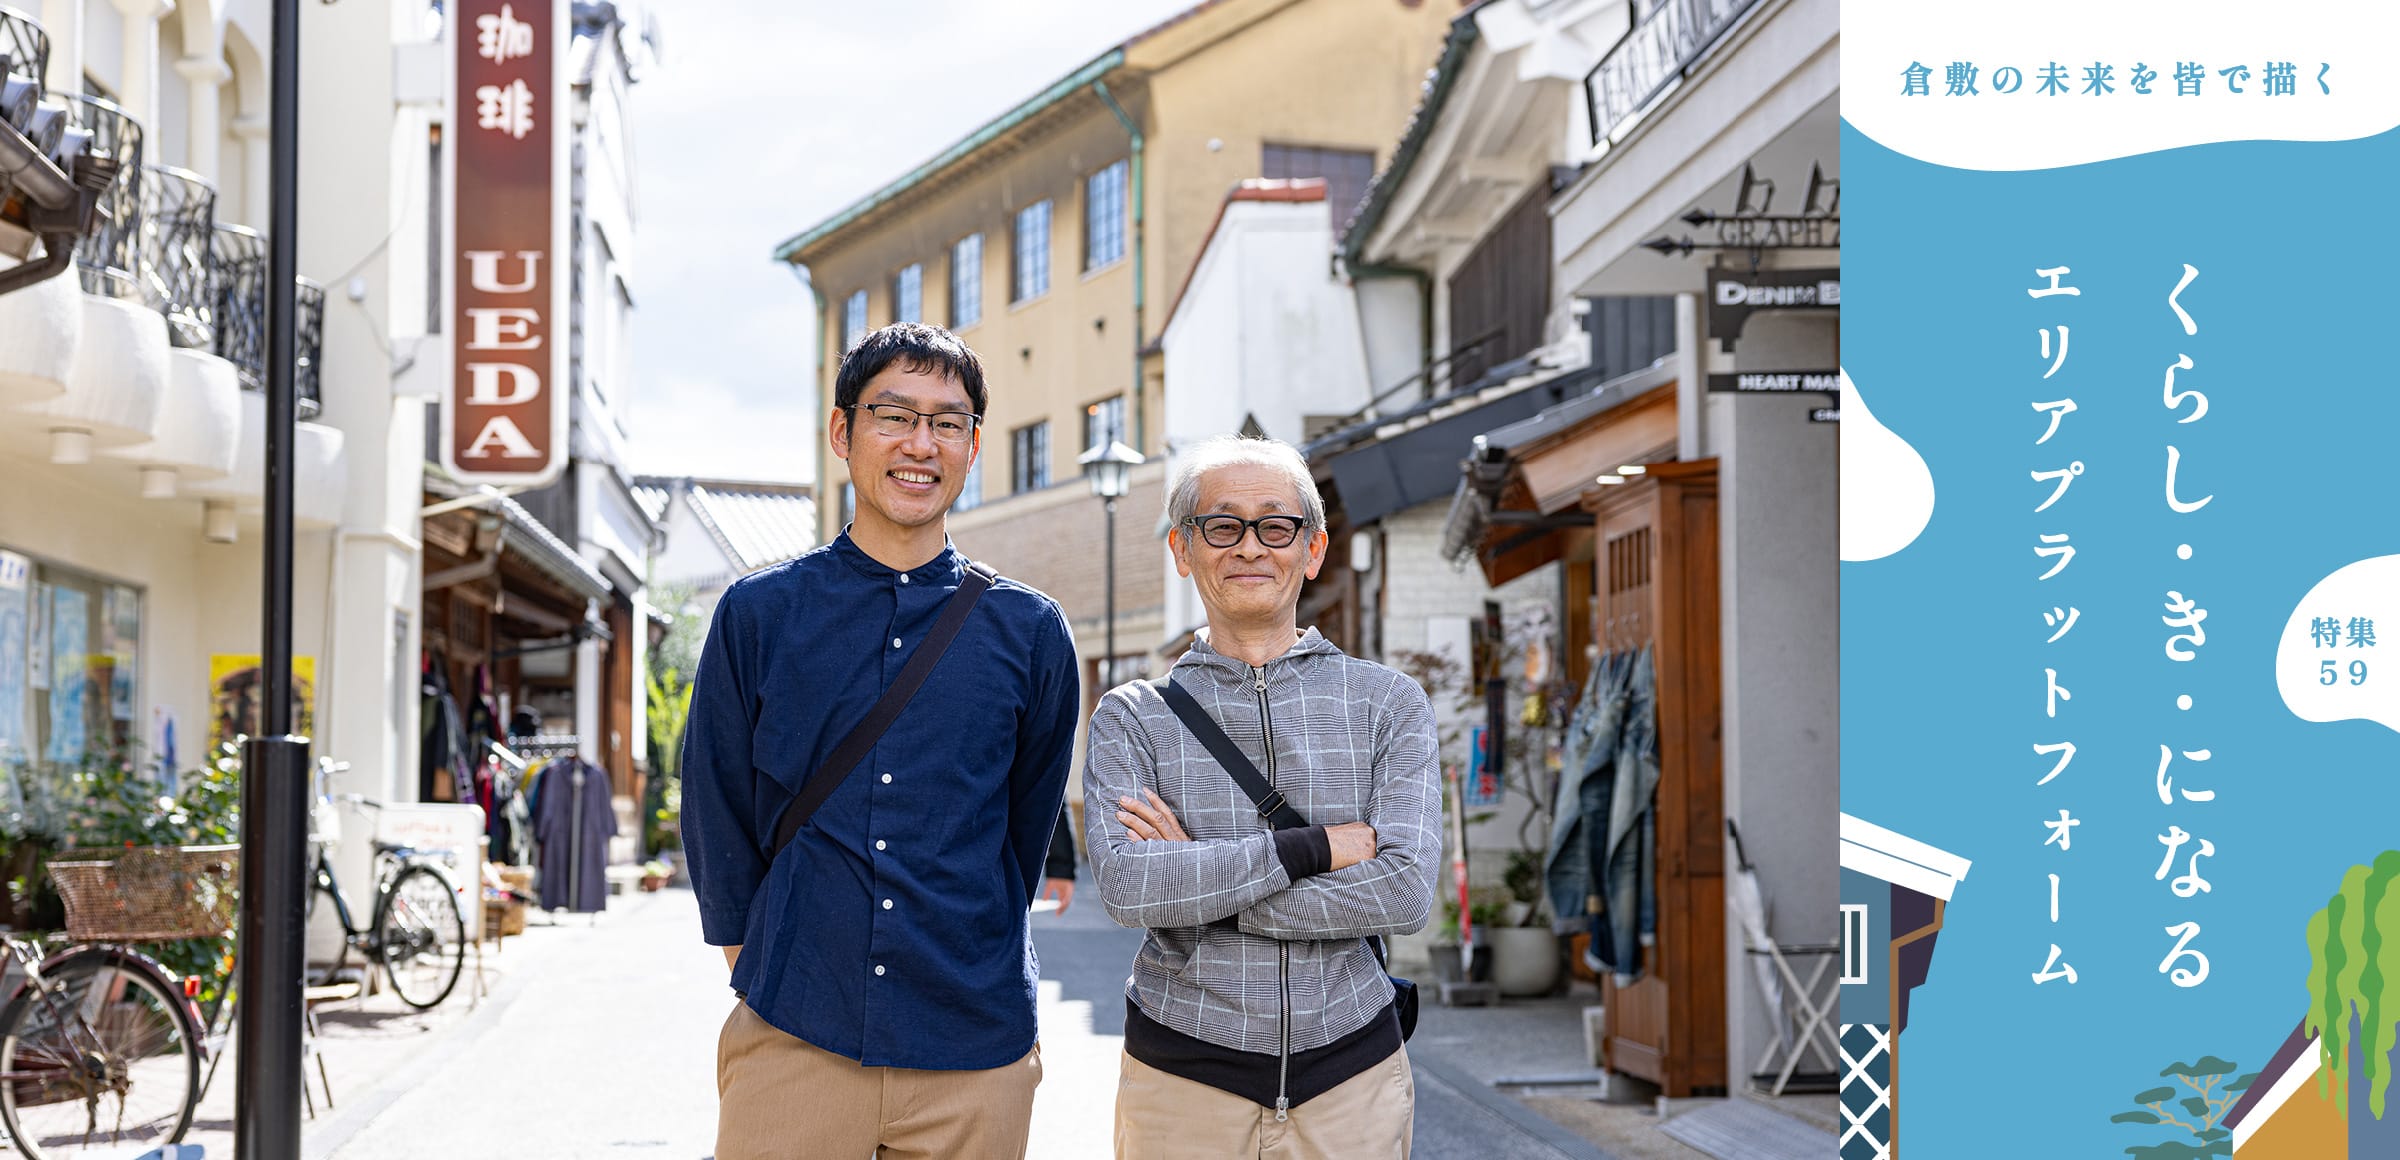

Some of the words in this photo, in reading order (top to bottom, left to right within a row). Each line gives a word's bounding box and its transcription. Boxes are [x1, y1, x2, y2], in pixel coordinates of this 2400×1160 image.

[476, 3, 534, 139] 珈琲
[463, 250, 544, 458] UEDA
[1737, 374, 1801, 391] HEART
